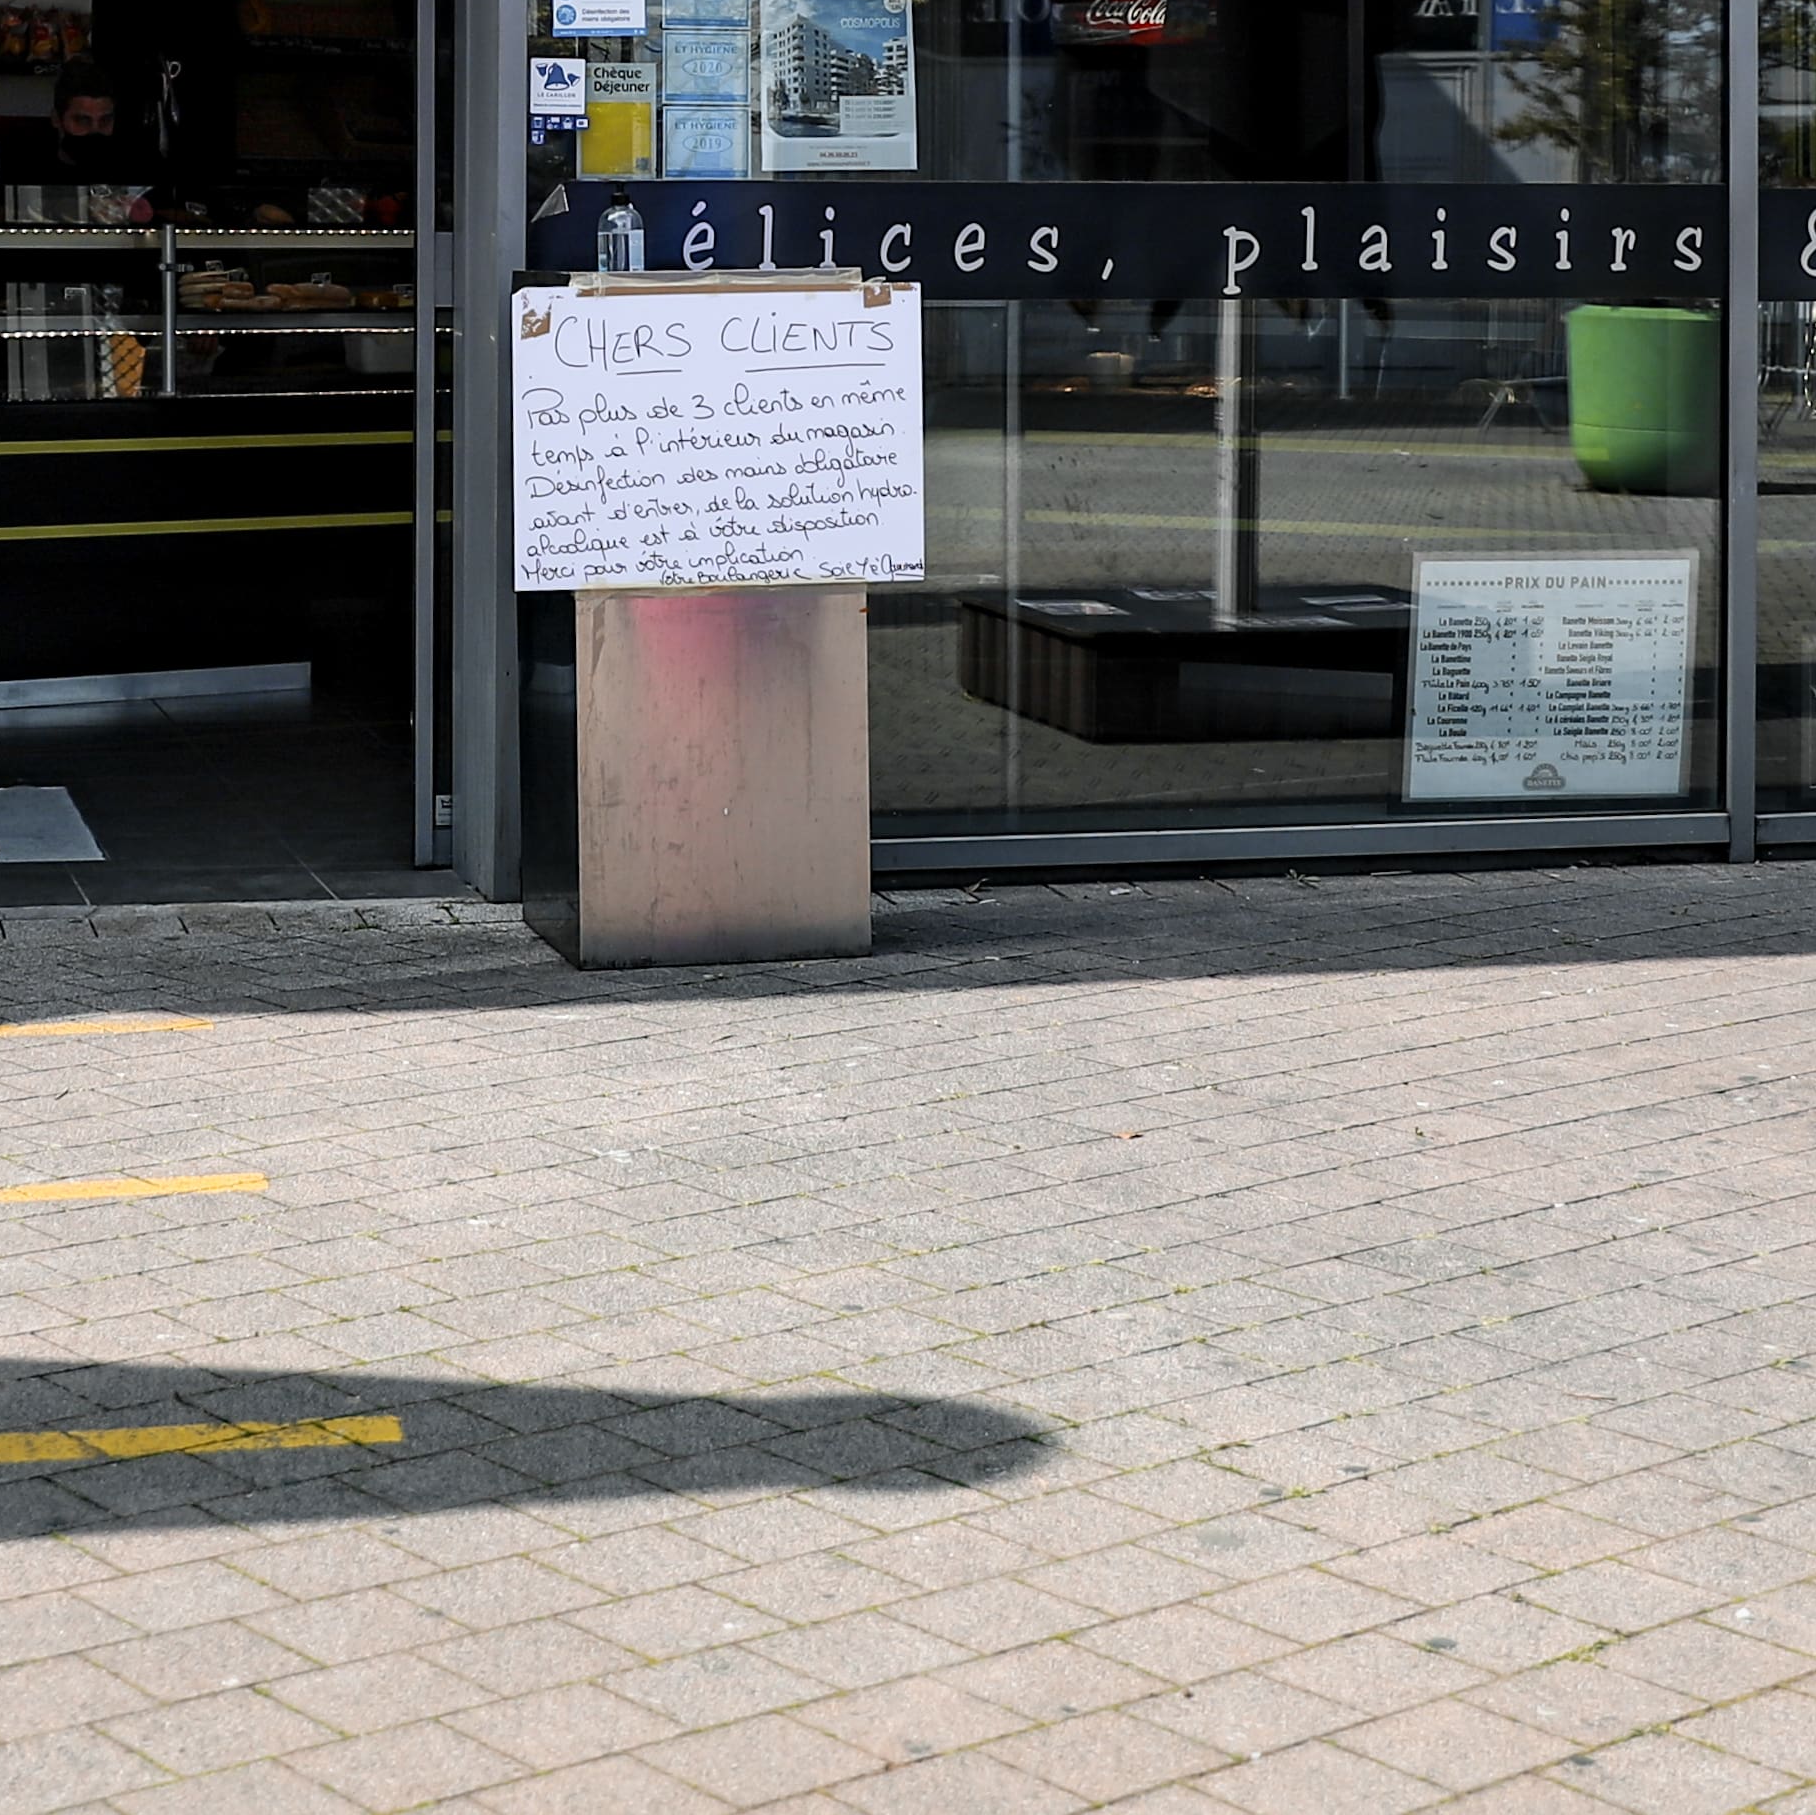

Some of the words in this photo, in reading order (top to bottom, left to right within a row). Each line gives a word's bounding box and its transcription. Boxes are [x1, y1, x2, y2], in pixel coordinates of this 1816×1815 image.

[840, 17, 901, 29] COSMOPOLIS
[593, 66, 642, 81] Chèque
[593, 80, 650, 95] Déjeuner
[692, 137, 722, 150] 2019
[683, 200, 1116, 281] élices,
[1222, 206, 1705, 296] plaisirs
[555, 315, 692, 372] CHERS
[522, 387, 570, 429] Pas
[579, 392, 637, 436] plus
[646, 396, 684, 419] de
[691, 394, 715, 420] 3
[724, 382, 803, 415] clients
[811, 395, 834, 408] en
[605, 433, 628, 458] à
[770, 422, 804, 446] du
[677, 467, 718, 486] des
[639, 523, 670, 545] est
[1505, 576, 1540, 589] PRIX
[1545, 576, 1565, 589] DU
[1570, 576, 1607, 589] PAIN
